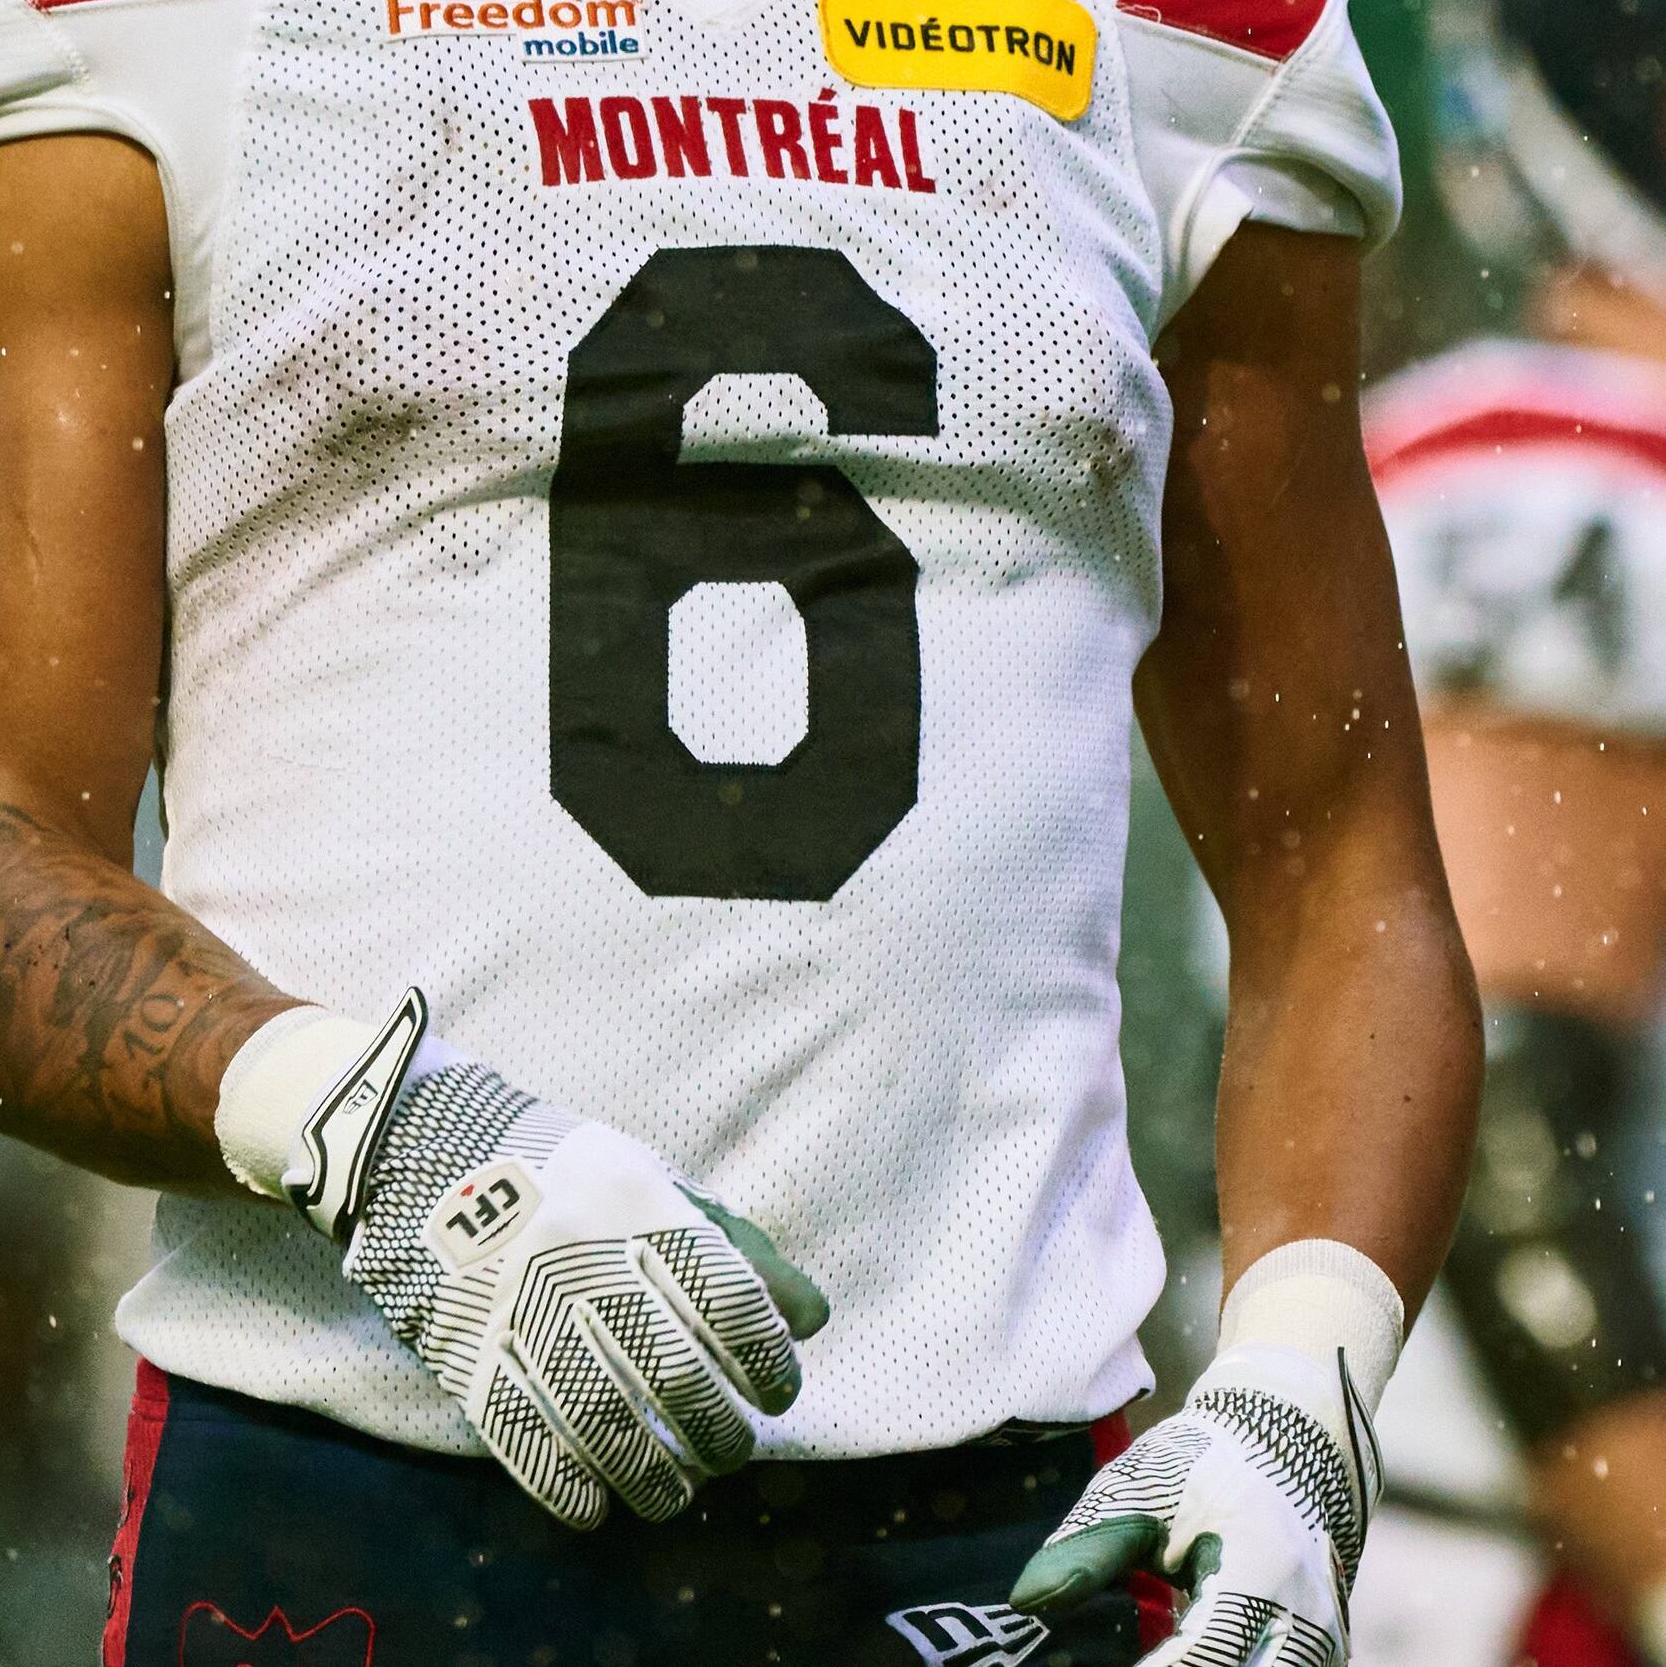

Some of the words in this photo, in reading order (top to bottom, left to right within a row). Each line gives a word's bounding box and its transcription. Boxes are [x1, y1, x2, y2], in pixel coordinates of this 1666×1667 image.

[522, 30, 640, 57] mobile
[843, 17, 1076, 76] VIDÉOTRON
[527, 87, 937, 195] MONTRÉAL
[549, 244, 940, 903] 6
[445, 1178, 521, 1239] CFL
